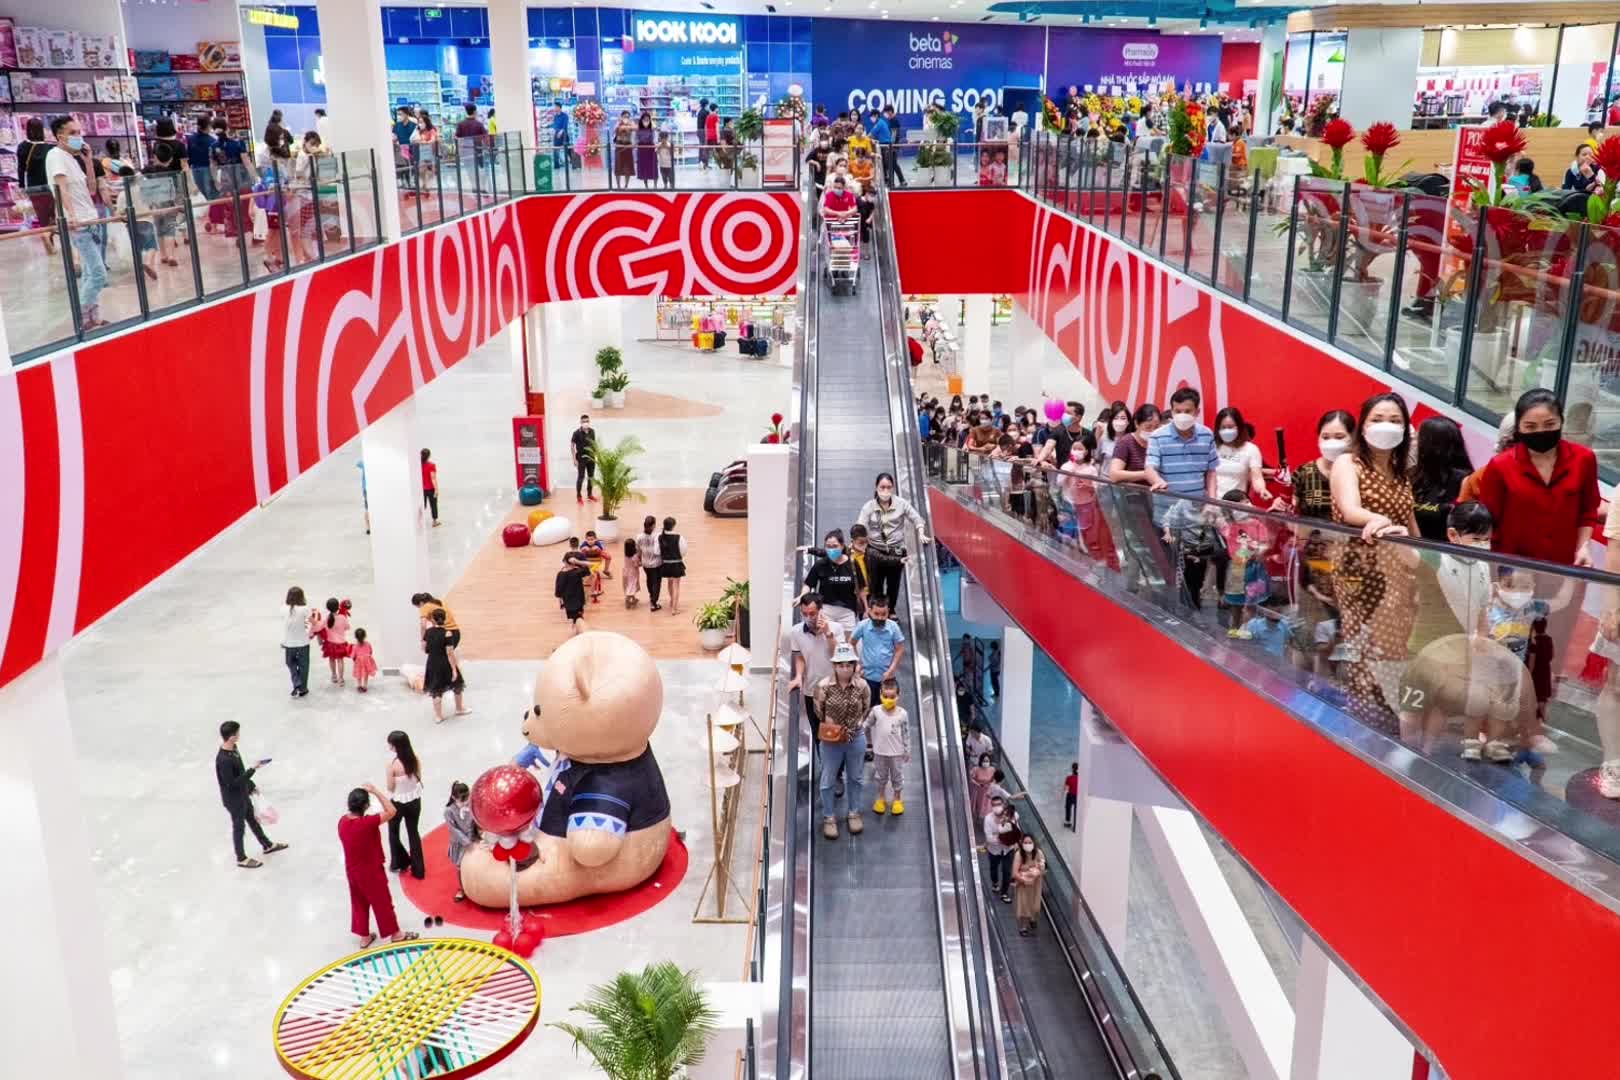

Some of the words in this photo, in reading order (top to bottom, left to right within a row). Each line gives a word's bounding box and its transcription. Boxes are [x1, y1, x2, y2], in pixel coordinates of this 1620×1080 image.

[909, 32, 942, 51] beta
[908, 54, 953, 69] cinemas
[1401, 686, 1425, 709] 12
